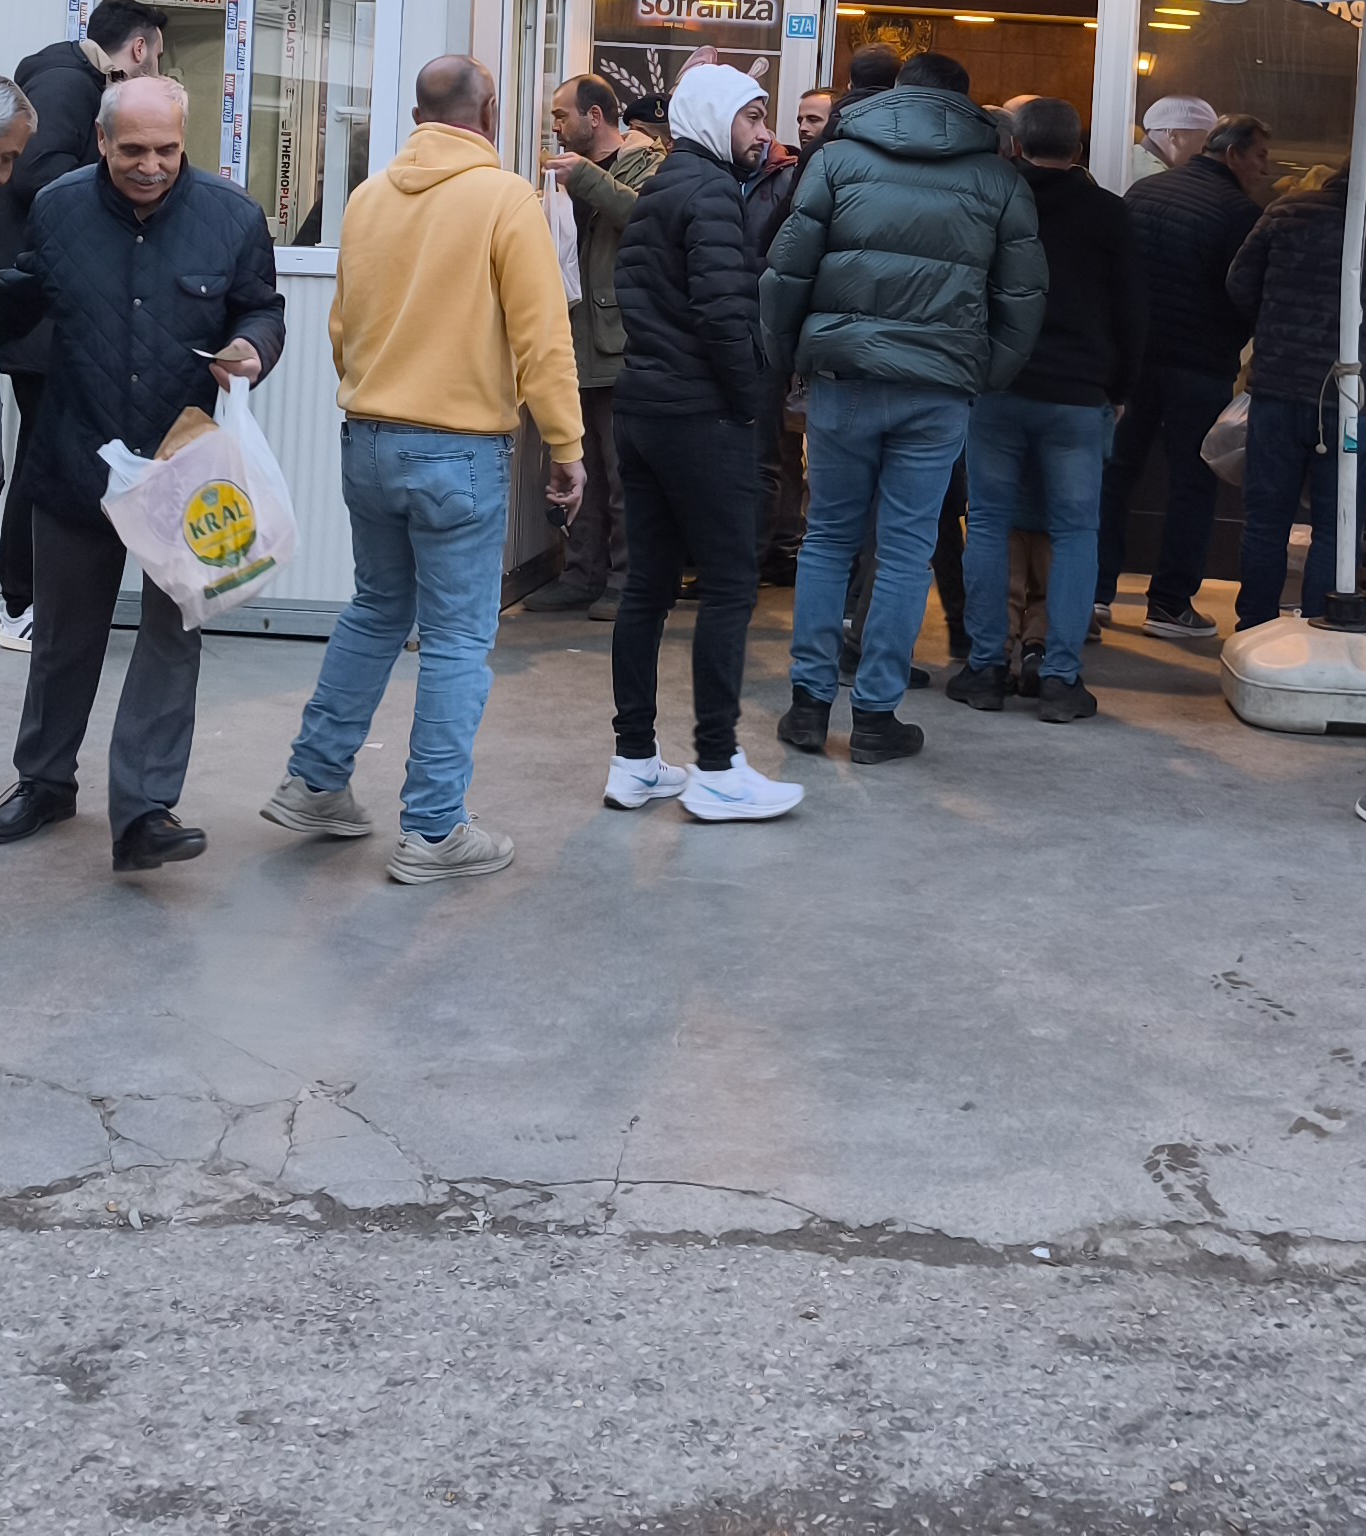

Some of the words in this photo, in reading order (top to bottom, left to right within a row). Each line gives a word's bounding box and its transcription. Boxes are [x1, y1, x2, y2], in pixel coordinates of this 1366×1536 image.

[227, 3, 239, 30] KOMP
[791, 17, 812, 34] 5/A
[224, 74, 235, 95] WIN
[223, 96, 235, 123] KOMP
[278, 137, 292, 227] THERMOPLAST
[188, 500, 248, 540] KRAL
